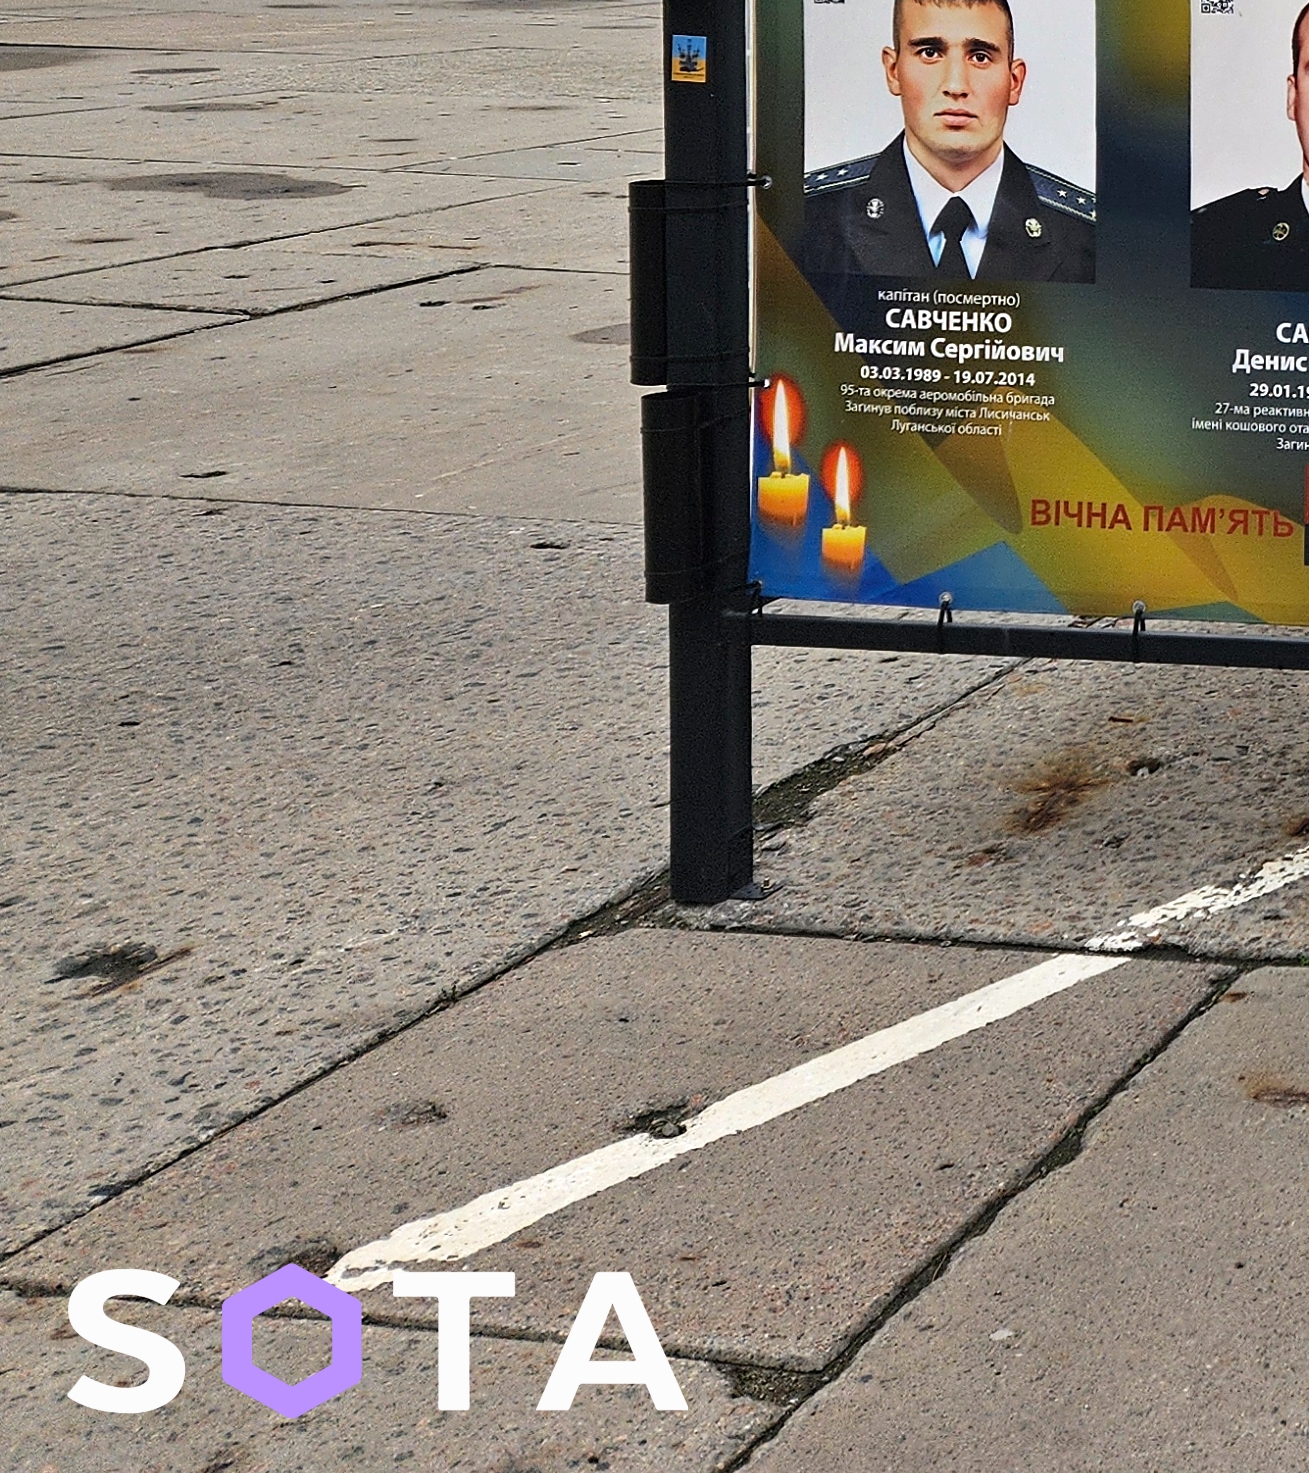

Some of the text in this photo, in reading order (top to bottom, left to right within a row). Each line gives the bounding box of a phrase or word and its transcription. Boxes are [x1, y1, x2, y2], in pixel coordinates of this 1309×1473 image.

[877, 288, 1020, 308] капітан (посмертно)
[885, 308, 1012, 332] САВЧЕНКО
[834, 332, 1064, 362] Максим Сергійович
[1232, 348, 1308, 373] Денис
[860, 365, 1036, 386] 03.03.1989 19.07.2014
[845, 399, 1050, 423] Загинув поблизу міста Лисичанськ
[890, 418, 1002, 435] Луганської області
[1191, 417, 1223, 430] імені
[1225, 421, 1287, 433] кошового
[1029, 498, 1130, 531] ВІЧНА
